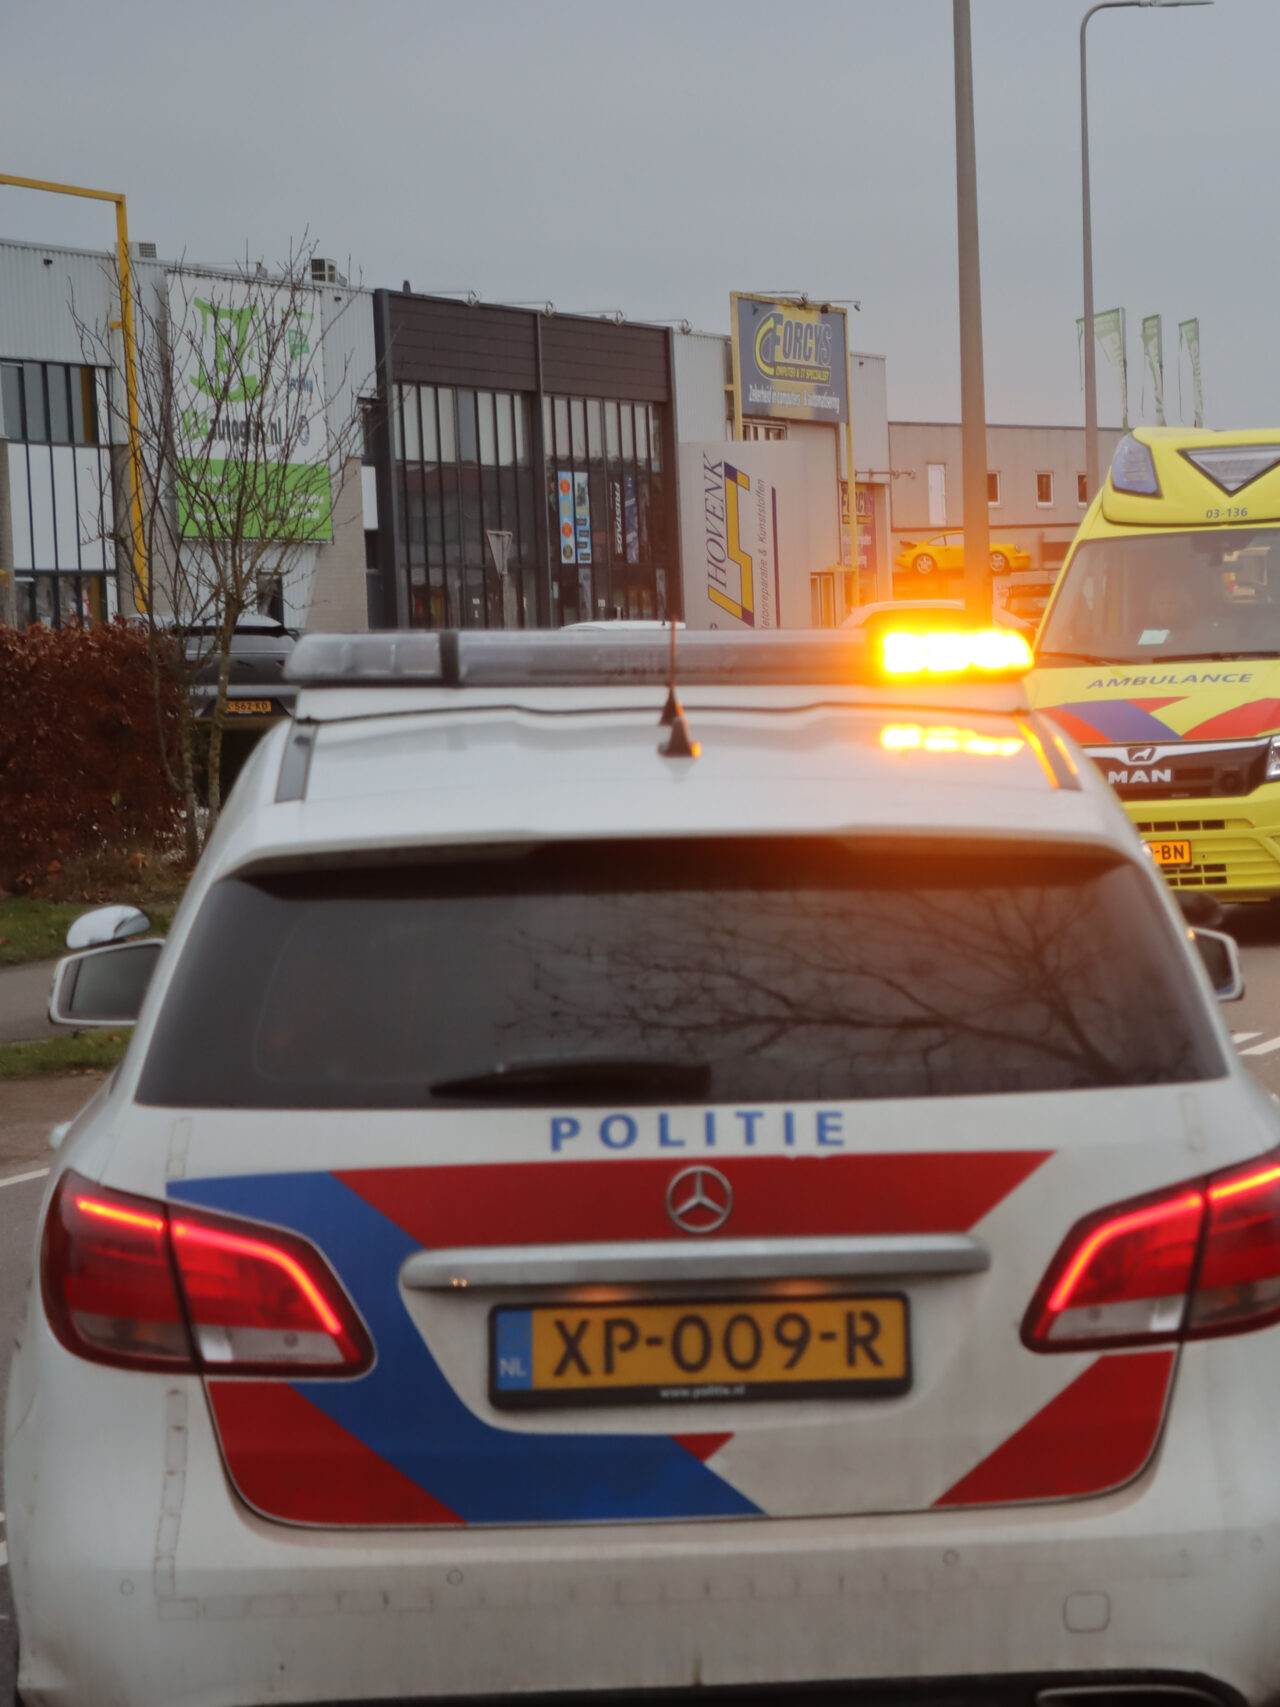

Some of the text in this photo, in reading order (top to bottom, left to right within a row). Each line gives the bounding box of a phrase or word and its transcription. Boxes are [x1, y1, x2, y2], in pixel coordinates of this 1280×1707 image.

[769, 312, 832, 367] FORCYS
[703, 450, 727, 589] HOVENK
[755, 479, 768, 545] Kunststoffen
[1206, 507, 1248, 519] 03-136
[1087, 673, 1253, 690] AMBULANCE
[1108, 769, 1172, 785] MAN
[550, 1110, 845, 1151] POLITIE
[501, 1310, 885, 1377] NL XP-009-R
[660, 1384, 746, 1399] www.politie.nl
